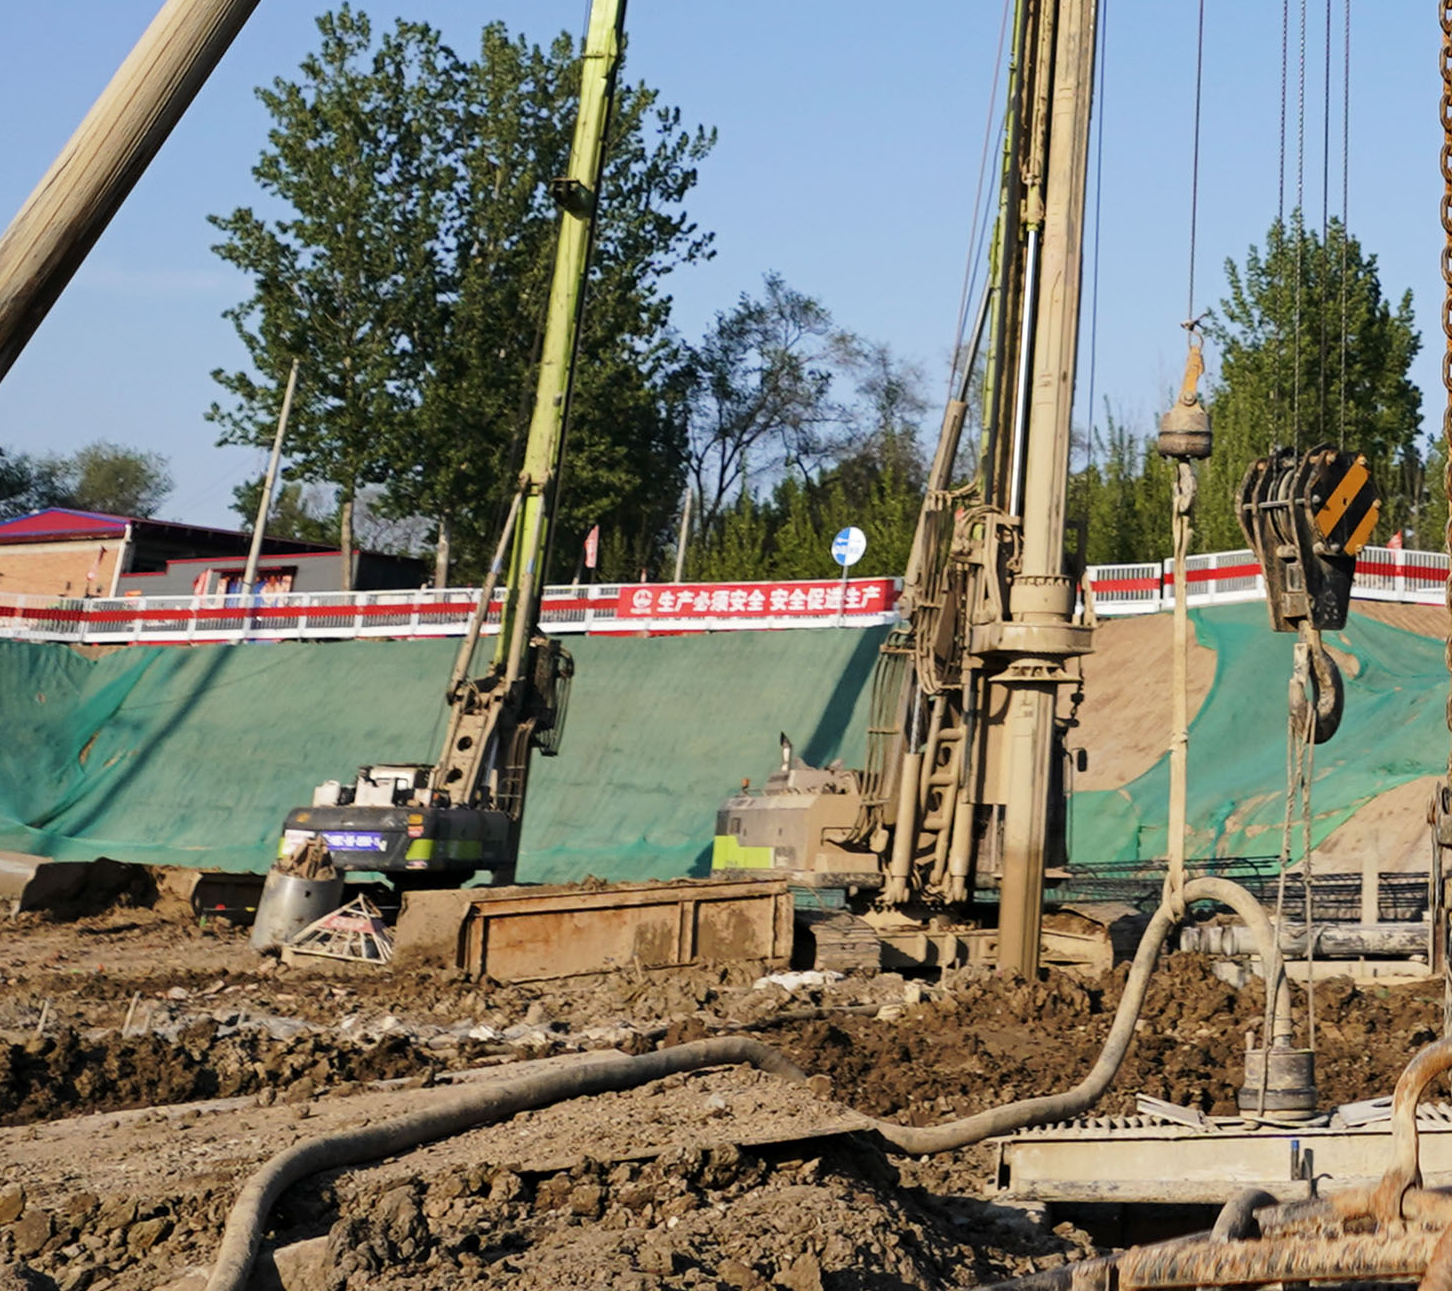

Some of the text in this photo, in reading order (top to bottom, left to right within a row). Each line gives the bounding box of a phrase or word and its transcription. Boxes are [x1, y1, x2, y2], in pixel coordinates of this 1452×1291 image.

[656, 585, 881, 612] 生产必须安全 安全促进生产
